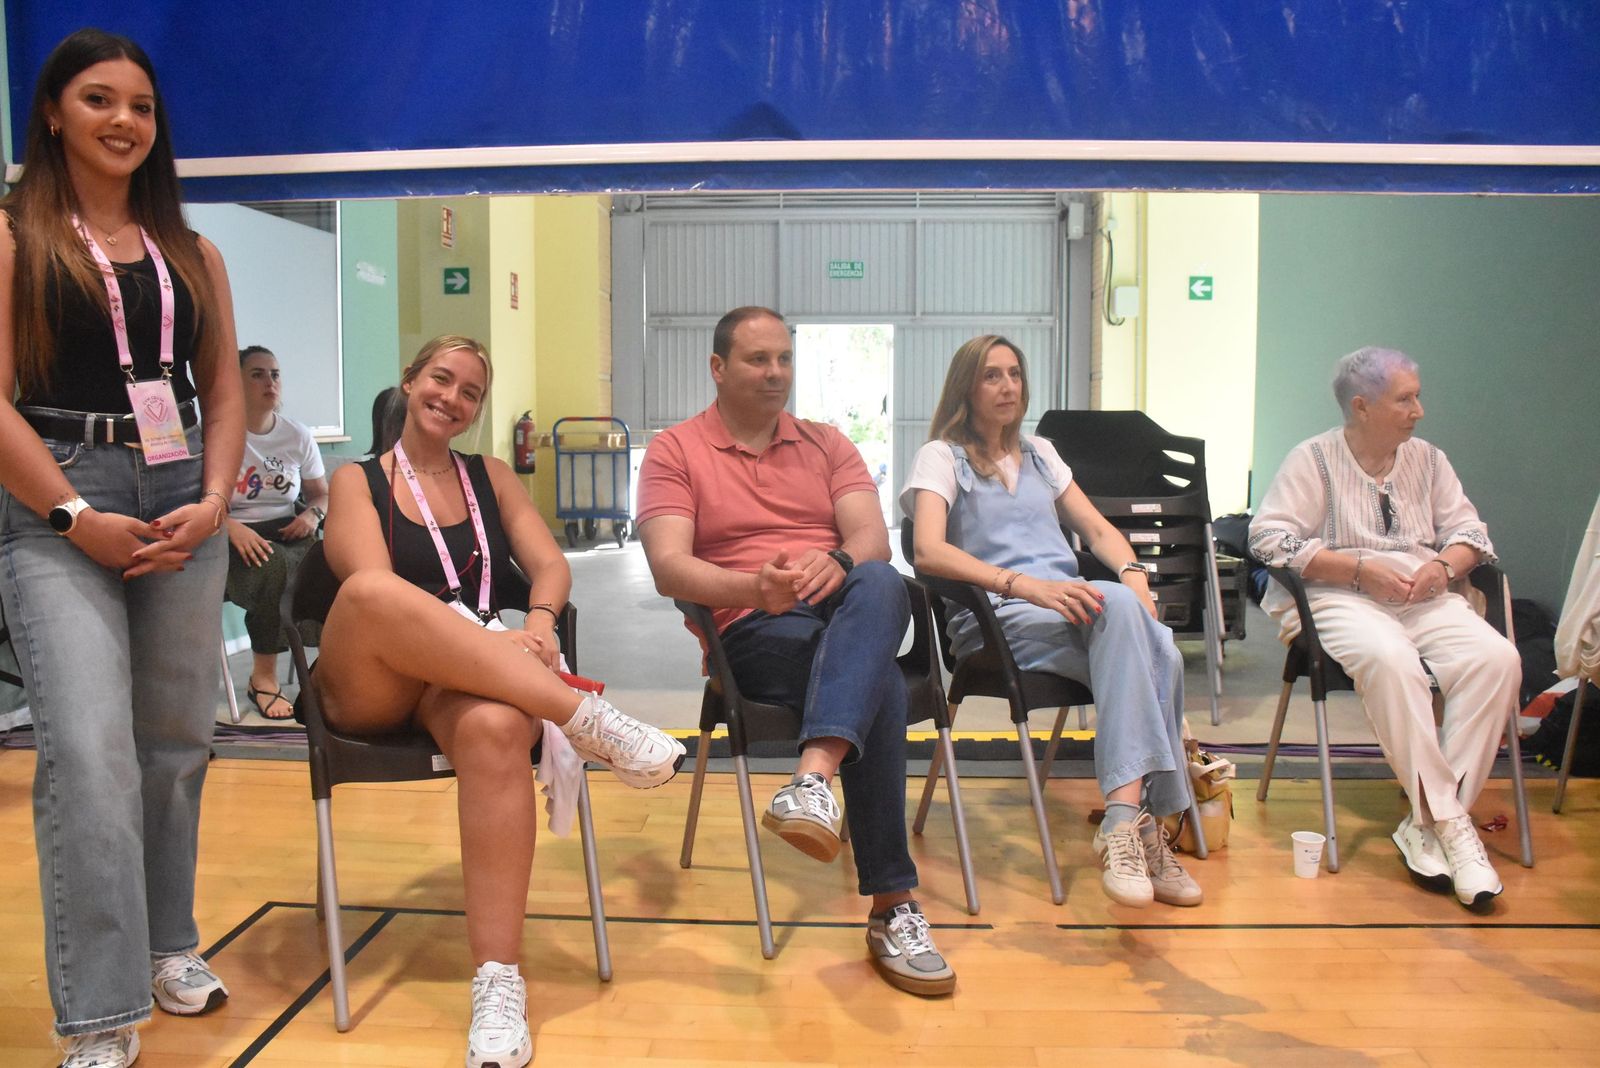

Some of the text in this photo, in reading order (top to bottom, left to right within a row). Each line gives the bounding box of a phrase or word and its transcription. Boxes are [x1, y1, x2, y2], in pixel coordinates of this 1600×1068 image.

[829, 262, 862, 270] SALIDA DE
[147, 449, 188, 462] ORGANIZACIÓN
